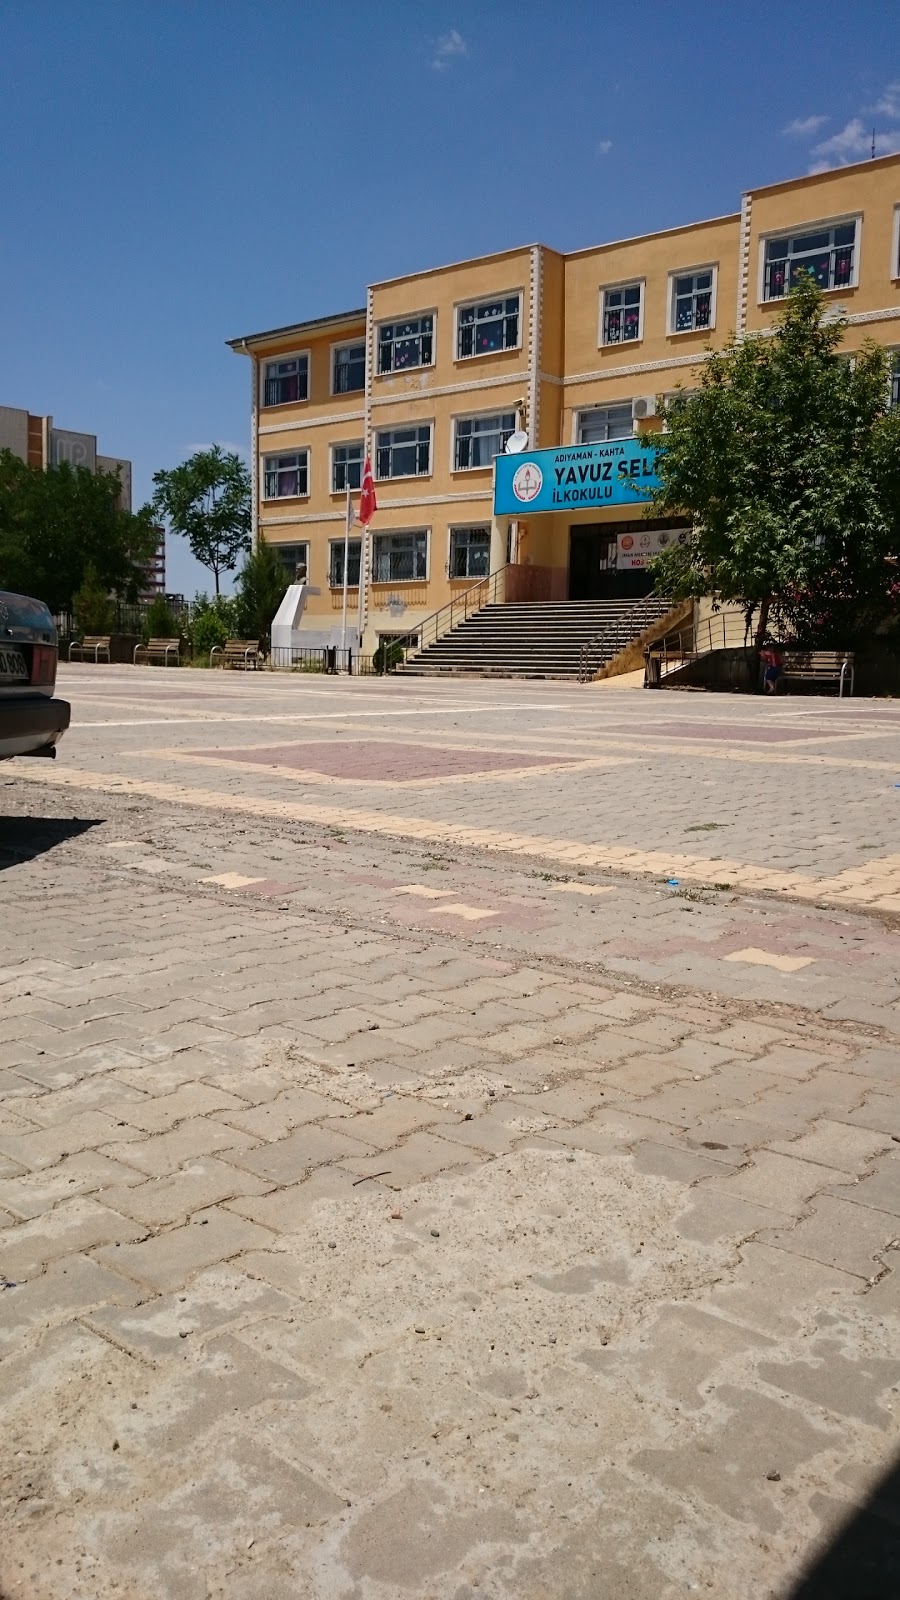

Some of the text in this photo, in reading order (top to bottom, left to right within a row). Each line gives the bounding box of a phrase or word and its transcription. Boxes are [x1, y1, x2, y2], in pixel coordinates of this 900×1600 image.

[555, 451, 593, 463] ADIYAMAN
[599, 447, 625, 457] KAHTA
[555, 462, 613, 486] YAVUZ
[617, 451, 660, 479] SELİ
[553, 485, 613, 504] İLKOKULU
